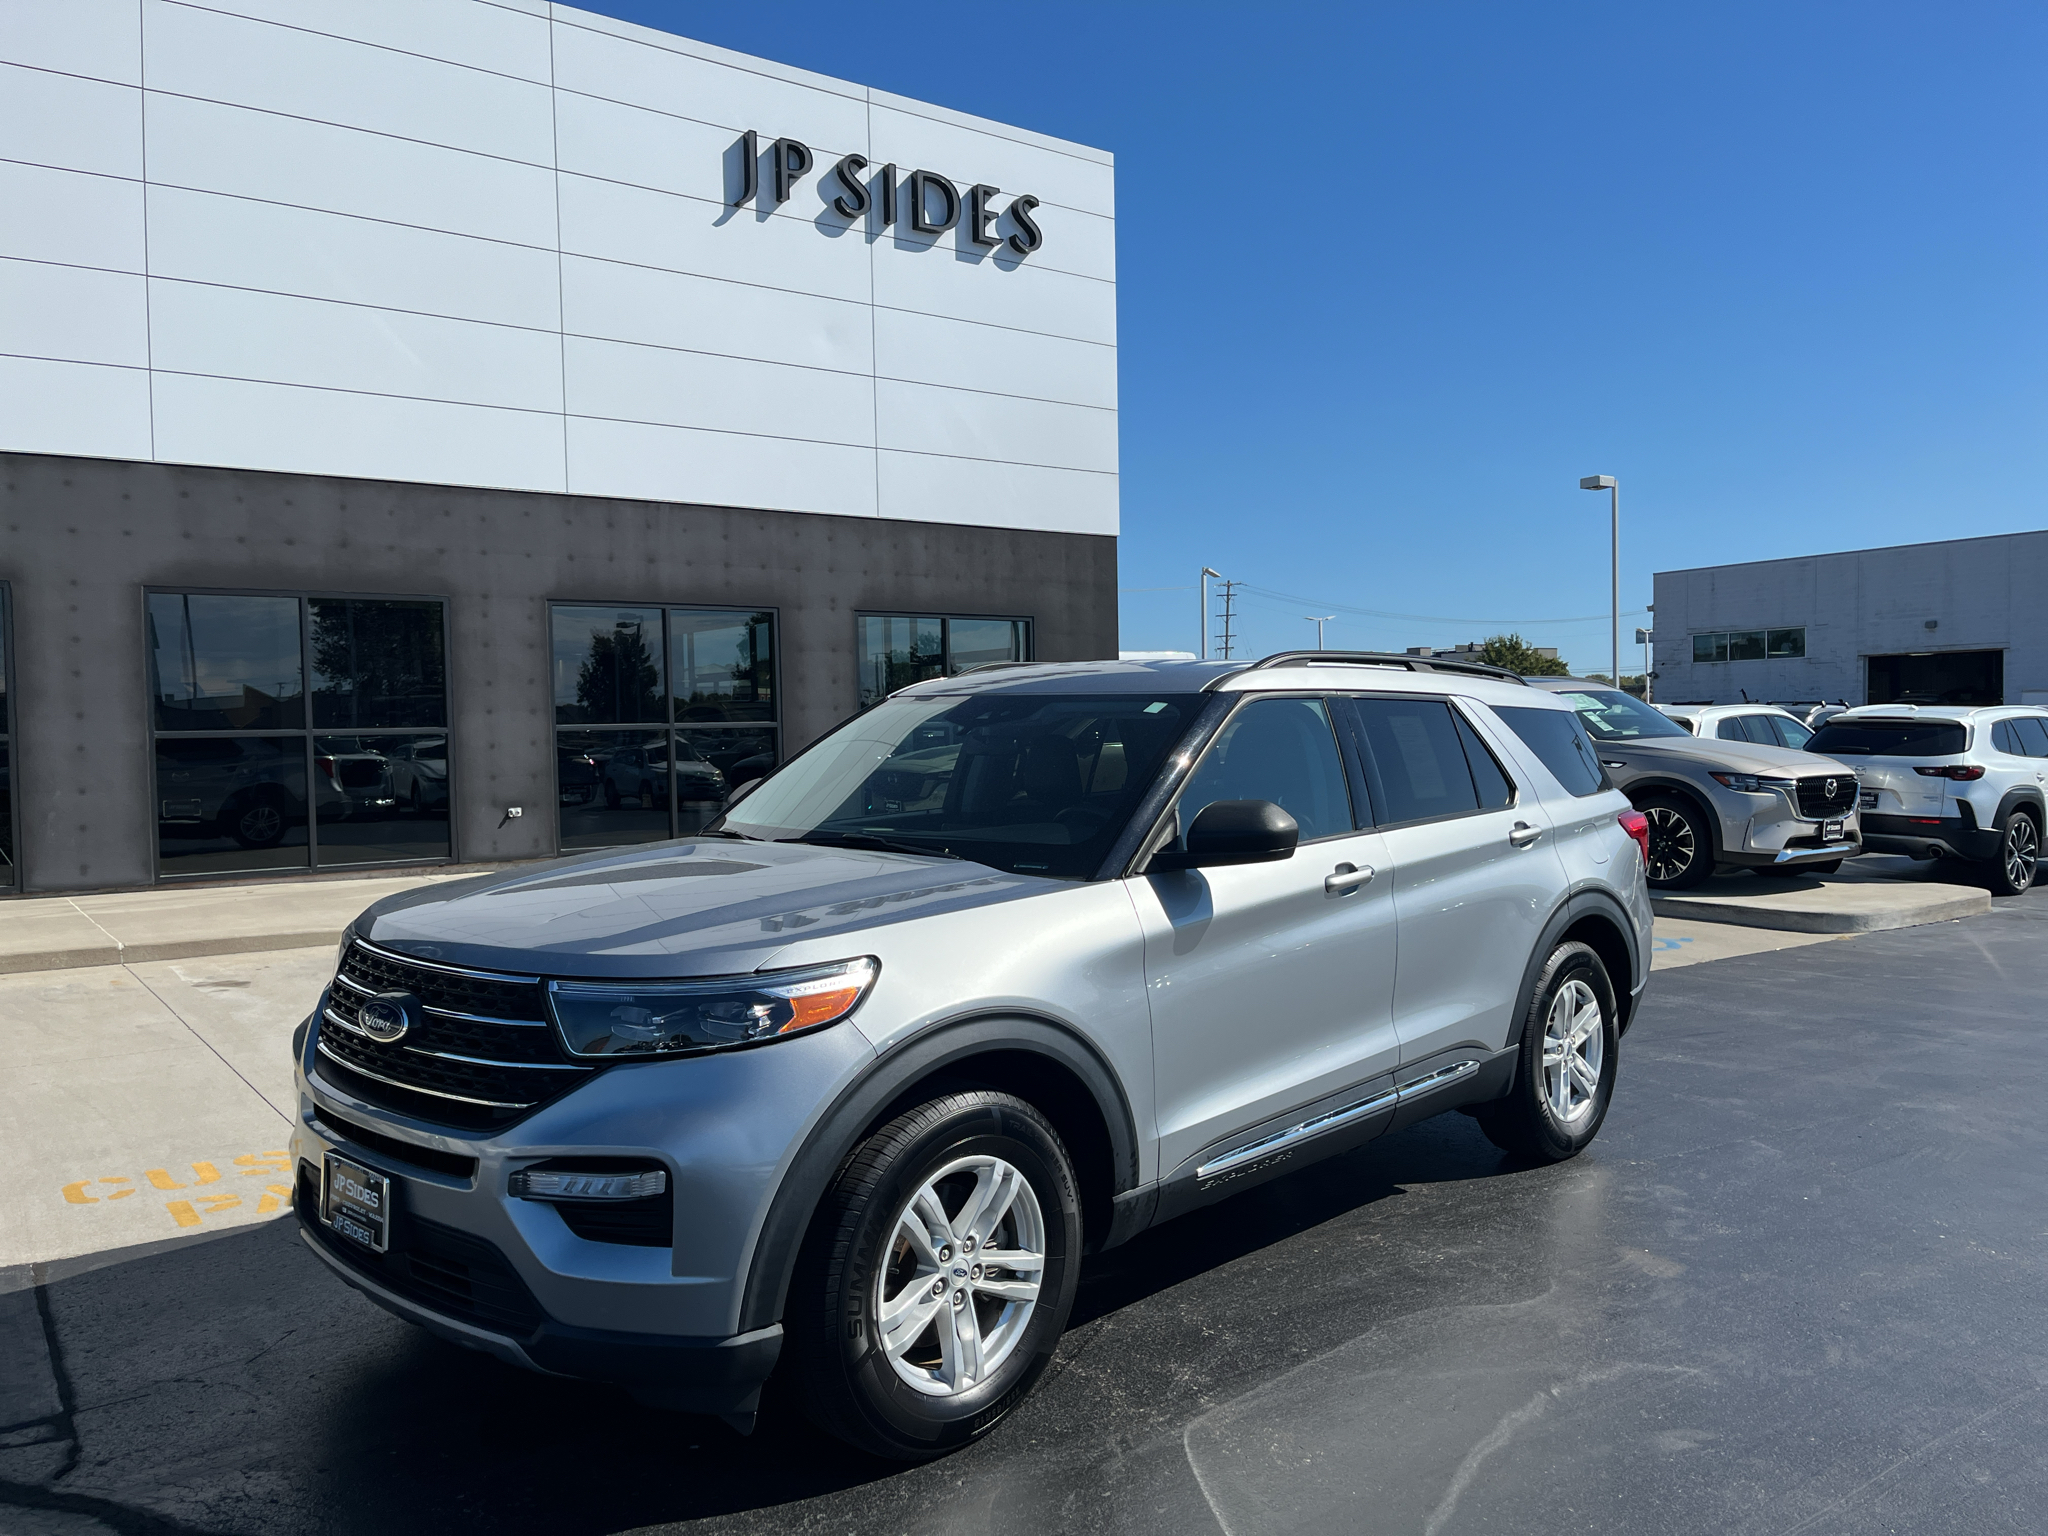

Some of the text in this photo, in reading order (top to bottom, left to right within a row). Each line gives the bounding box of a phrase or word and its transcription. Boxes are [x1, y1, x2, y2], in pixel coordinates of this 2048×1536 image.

[733, 129, 1043, 255] JP SIDES
[333, 1173, 379, 1208] JP SIDES
[333, 1215, 370, 1244] JP SIDES
